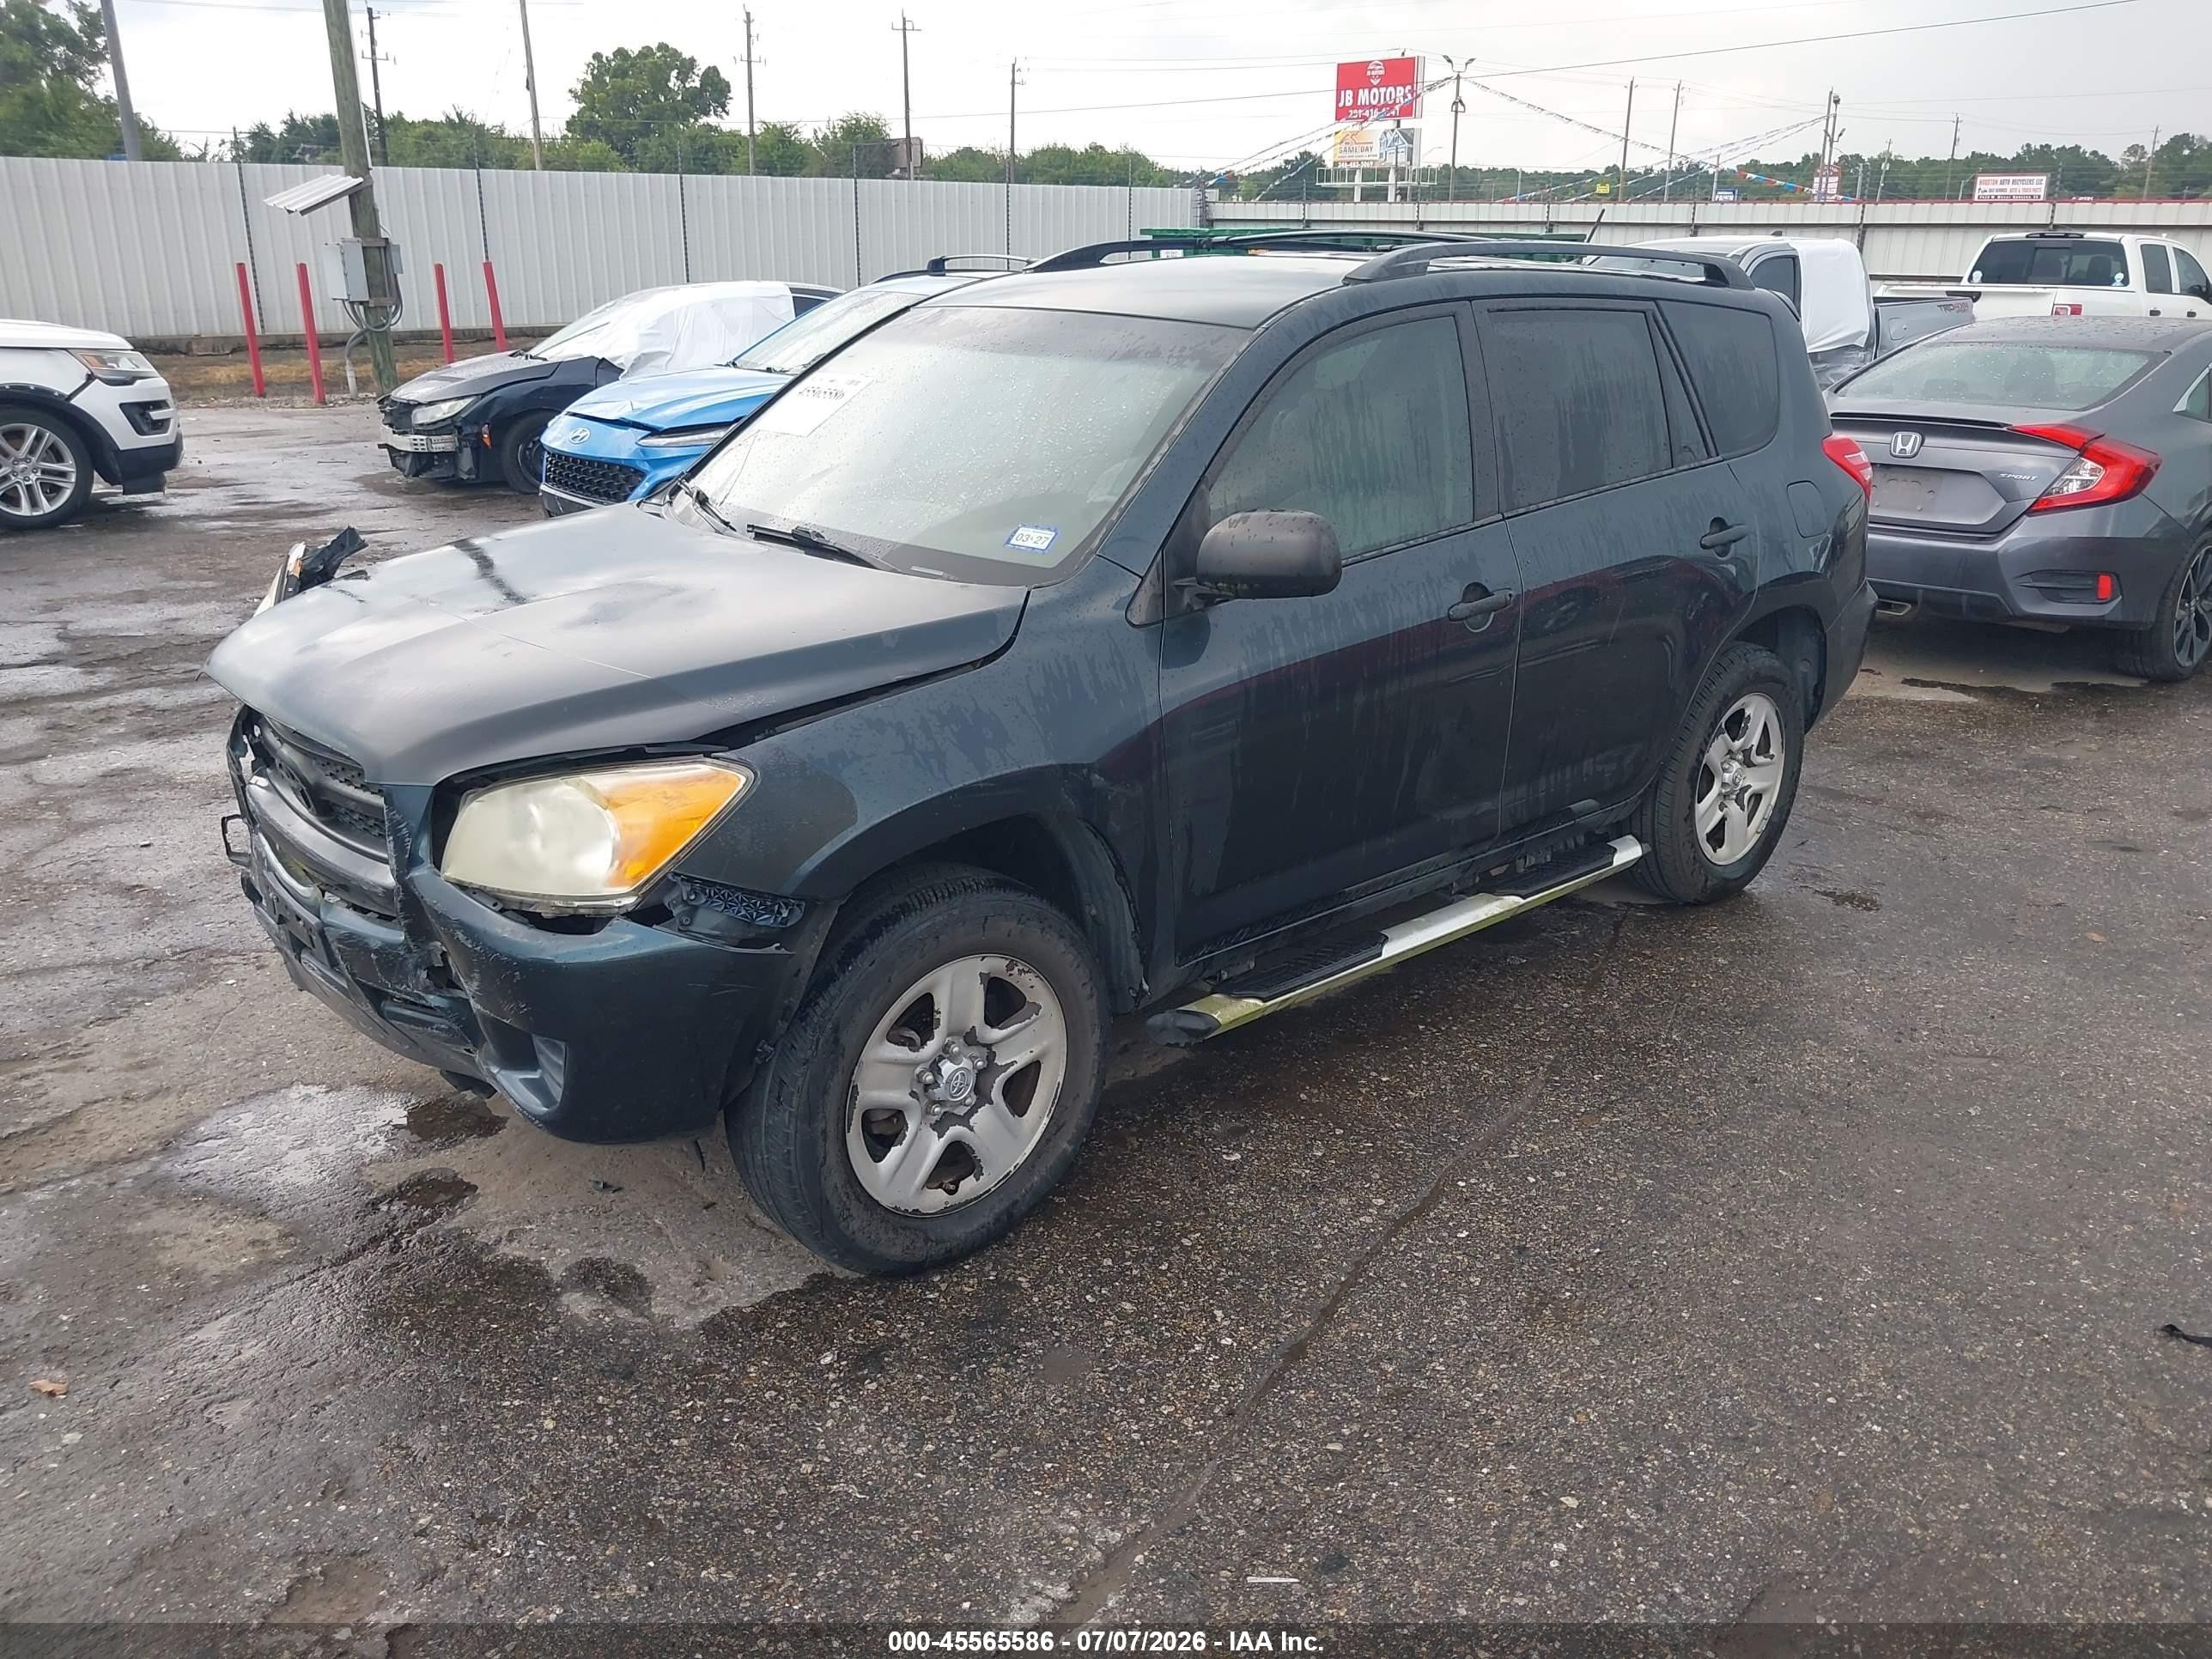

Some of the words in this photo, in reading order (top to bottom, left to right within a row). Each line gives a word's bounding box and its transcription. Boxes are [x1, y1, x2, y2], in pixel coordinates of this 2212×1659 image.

[1338, 89, 1353, 107] JB
[1358, 85, 1413, 106] MOTORS
[1937, 304, 1955, 314] TRD
[1015, 532, 1030, 543] 03
[1033, 535, 1049, 545] 27
